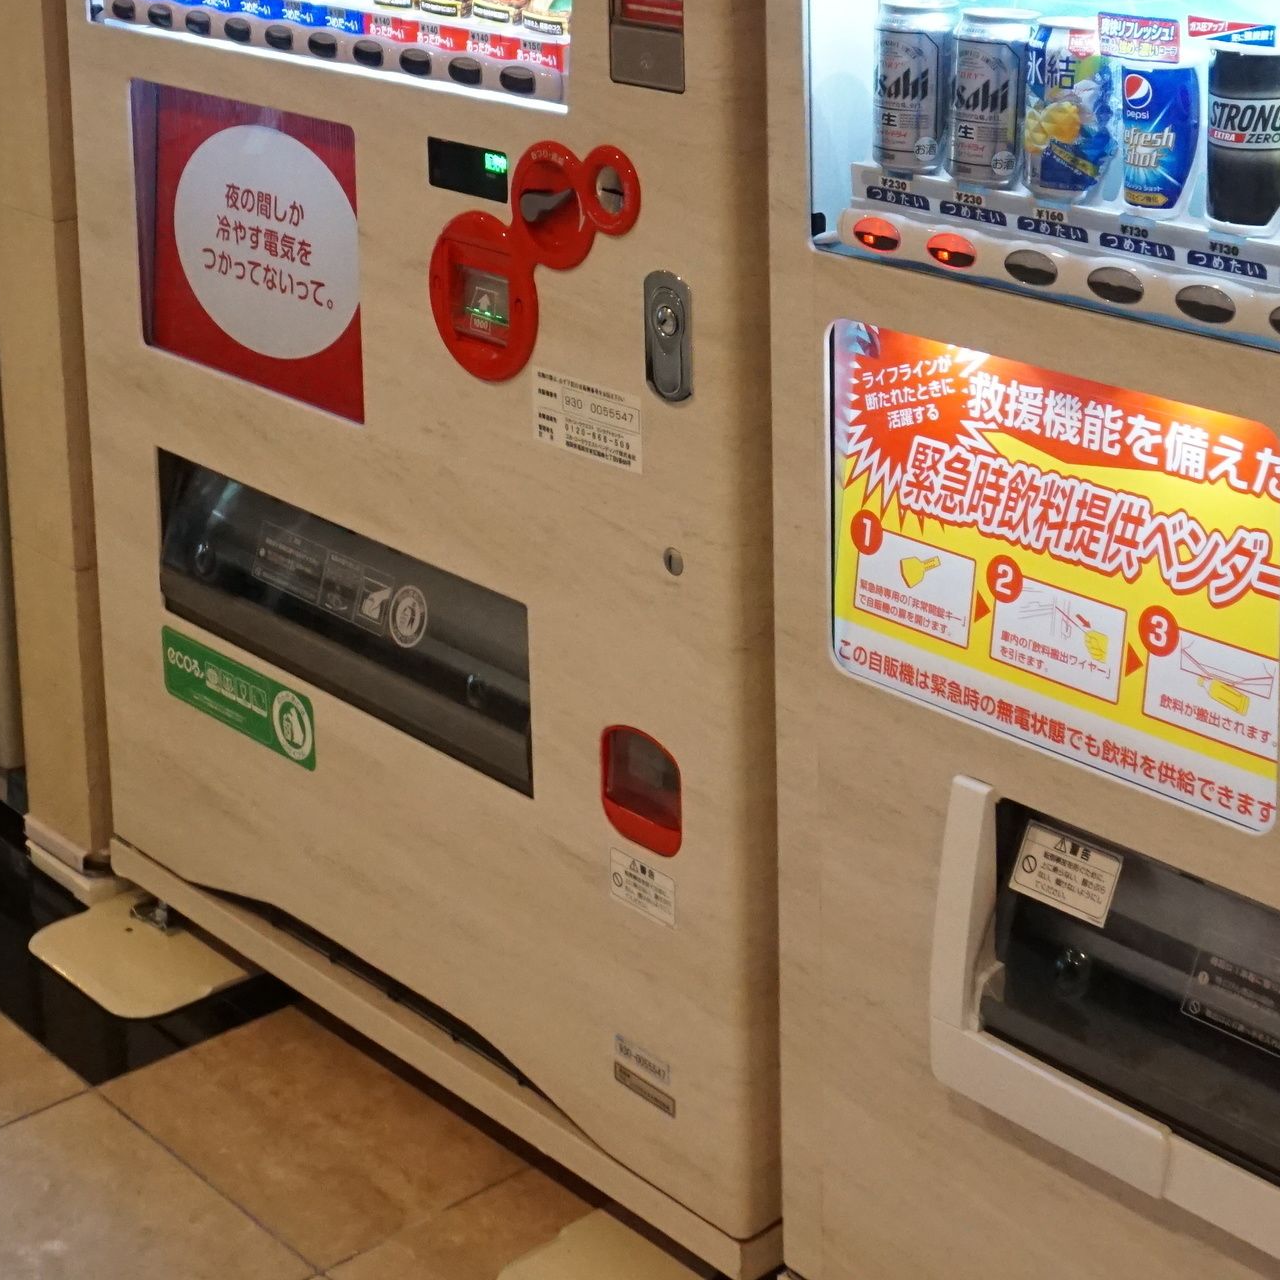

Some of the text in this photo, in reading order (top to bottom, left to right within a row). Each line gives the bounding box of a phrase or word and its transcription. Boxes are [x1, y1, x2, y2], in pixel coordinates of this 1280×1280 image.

[1026, 54, 1075, 89] 氷結
[882, 113, 897, 127] 生
[1126, 110, 1150, 120] pepsi
[958, 124, 974, 139] 生
[1214, 132, 1236, 142] EXTRA
[915, 143, 937, 156] お酒
[992, 158, 1014, 170] お酒
[881, 178, 907, 191] ¥230
[225, 183, 304, 227] 夜の間しか
[872, 188, 924, 208] つめたい
[955, 192, 983, 206] ¥230
[1036, 209, 1064, 222] ¥160
[216, 214, 312, 266] 冷やす電気を
[1121, 225, 1149, 239] ¥130
[1209, 241, 1239, 256] ¥130
[202, 248, 333, 310] つかってないって。
[862, 356, 953, 389] ライフラインが
[865, 376, 956, 412] 断たれたときに
[565, 396, 634, 422] 930 0055547
[887, 403, 940, 430] 活躍する
[859, 516, 875, 546] 1
[994, 563, 1014, 595] 2
[1148, 615, 1168, 647] 3
[999, 647, 1049, 673] を引きます。
[1159, 693, 1278, 748] 飲料が搬出されます。
